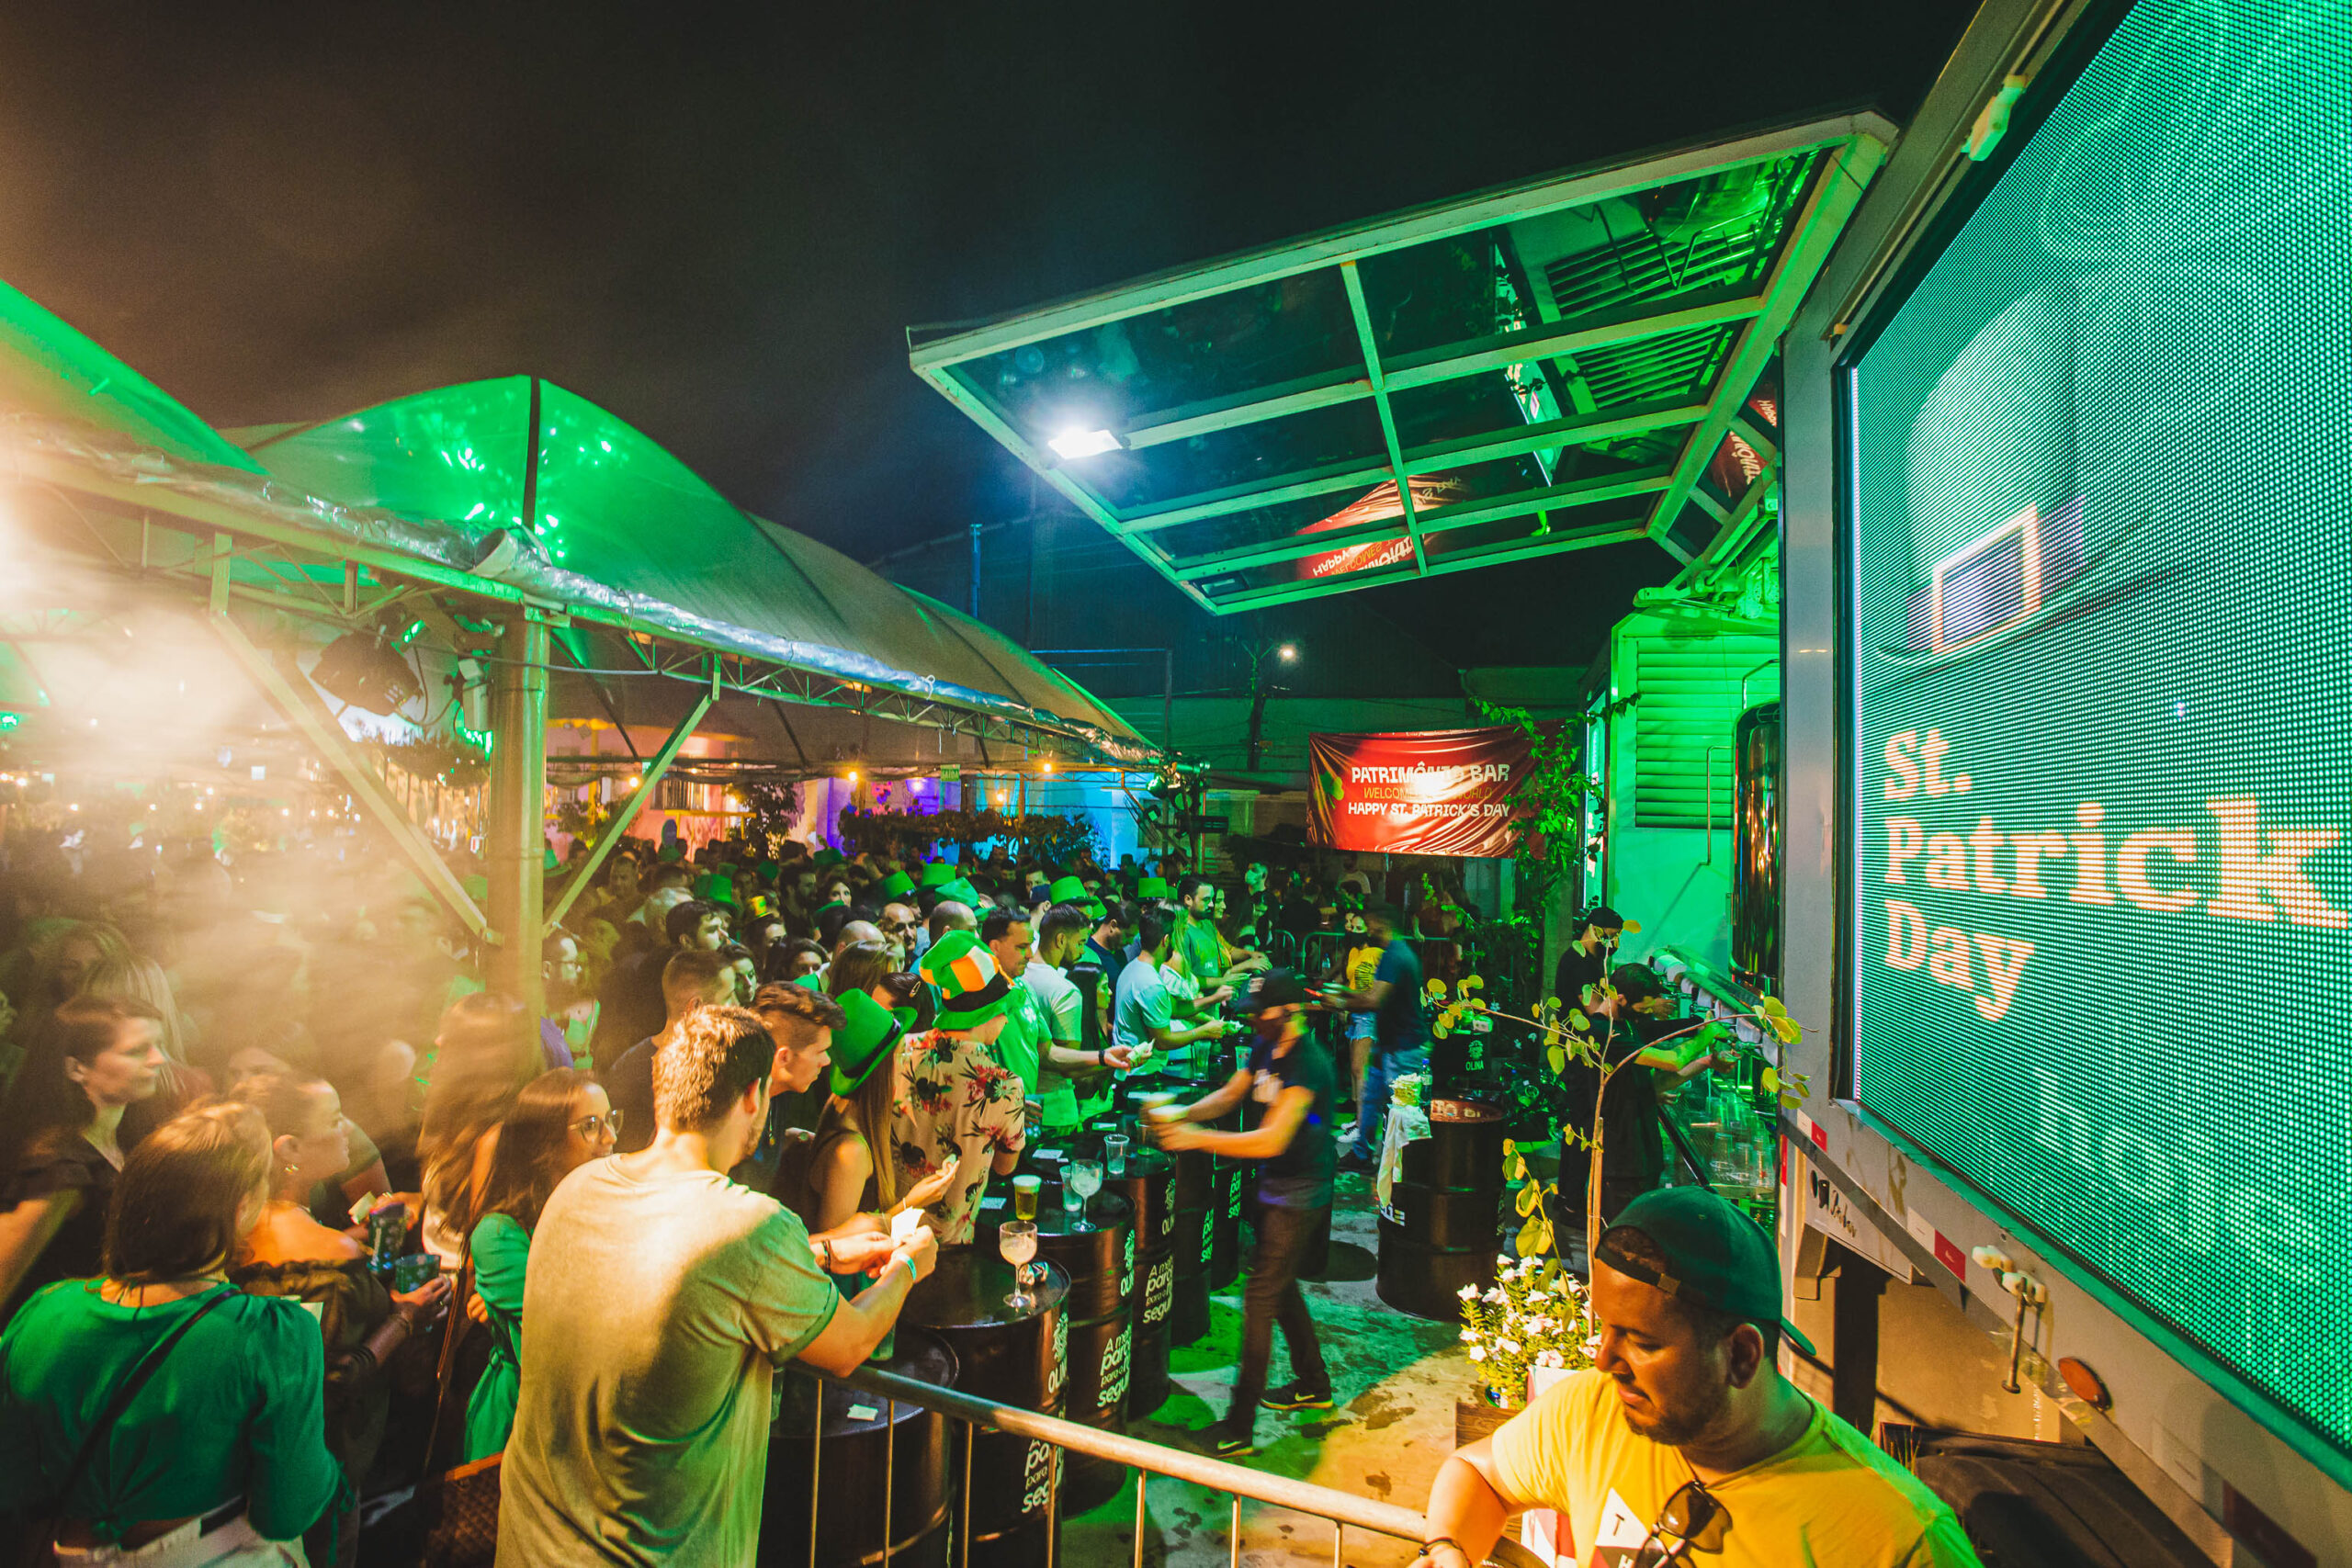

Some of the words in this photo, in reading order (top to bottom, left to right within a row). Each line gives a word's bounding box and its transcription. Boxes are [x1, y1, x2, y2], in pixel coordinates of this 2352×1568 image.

[1470, 764, 1510, 782] BAR
[1883, 728, 1973, 802] St.
[1348, 803, 1387, 815] HAPPY
[1390, 803, 1409, 816] ST.
[1412, 803, 1480, 817] PATRICK'S
[1484, 804, 1510, 817] DAY
[1883, 792, 2349, 930] Patrick
[1883, 898, 2036, 1023] Day
